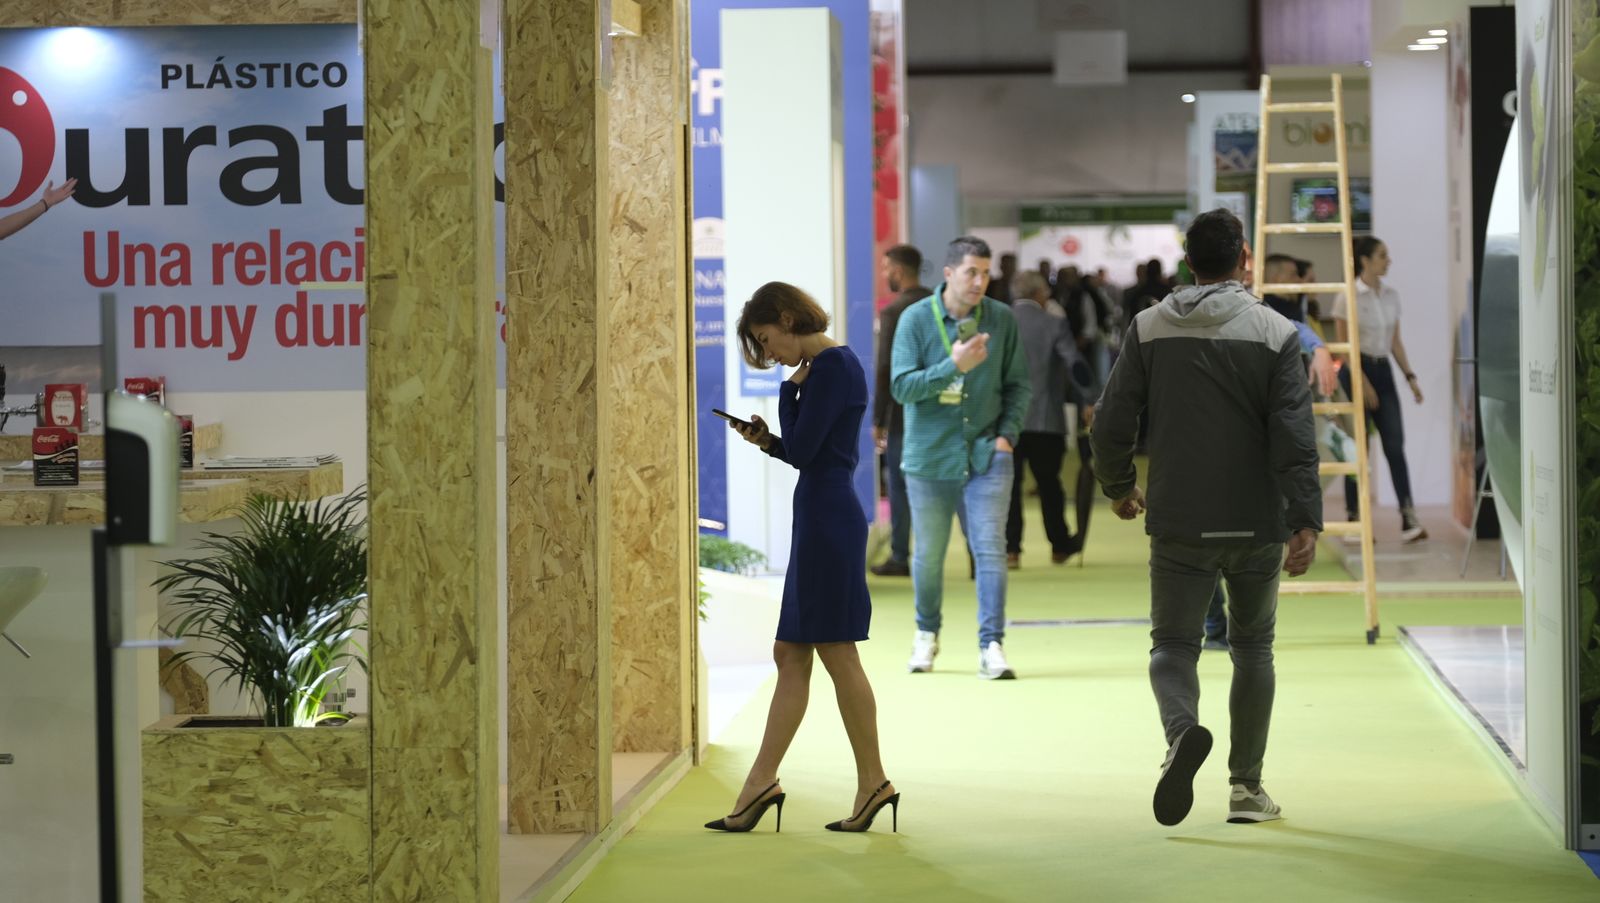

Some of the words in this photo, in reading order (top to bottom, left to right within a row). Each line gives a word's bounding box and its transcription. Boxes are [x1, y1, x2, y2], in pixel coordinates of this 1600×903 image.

[161, 56, 348, 89] PLÁSTICO
[83, 230, 192, 287] Una
[212, 229, 364, 285] relaci
[133, 304, 257, 361] muy
